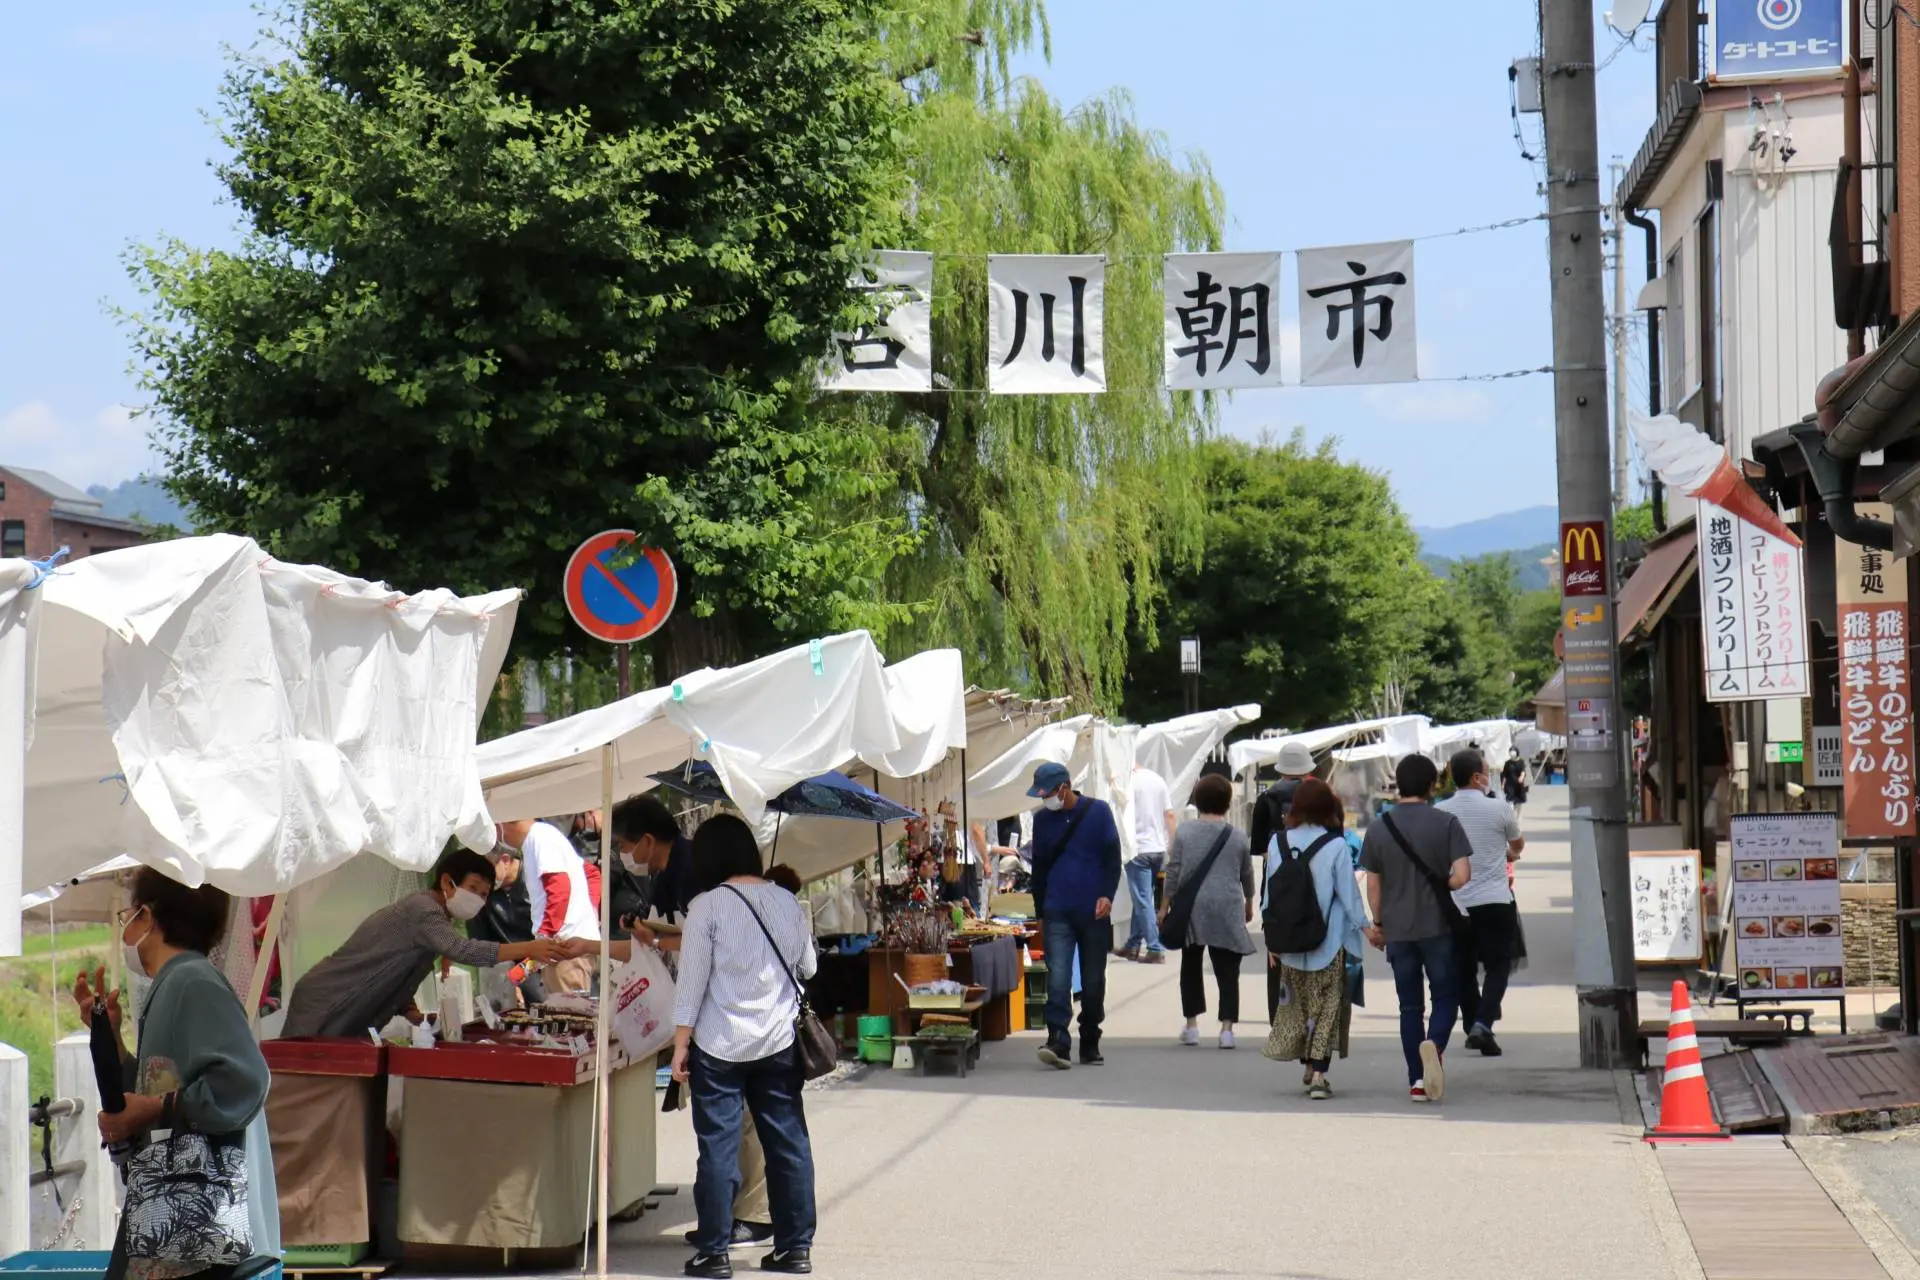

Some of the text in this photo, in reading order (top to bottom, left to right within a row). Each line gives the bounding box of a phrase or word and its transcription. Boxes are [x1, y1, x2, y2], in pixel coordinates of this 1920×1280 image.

[1722, 38, 1839, 60] ダートコーヒー
[1709, 516, 1740, 692] 地酒ソフトクリーム
[1750, 534, 1776, 689] コーヒーソフトクリーム
[1859, 512, 1885, 595] 事処
[1843, 611, 1876, 774] 飛騨牛うどん
[1876, 610, 1910, 827] 飛騨牛のどんぶり
[1735, 836, 1791, 848] モーニング
